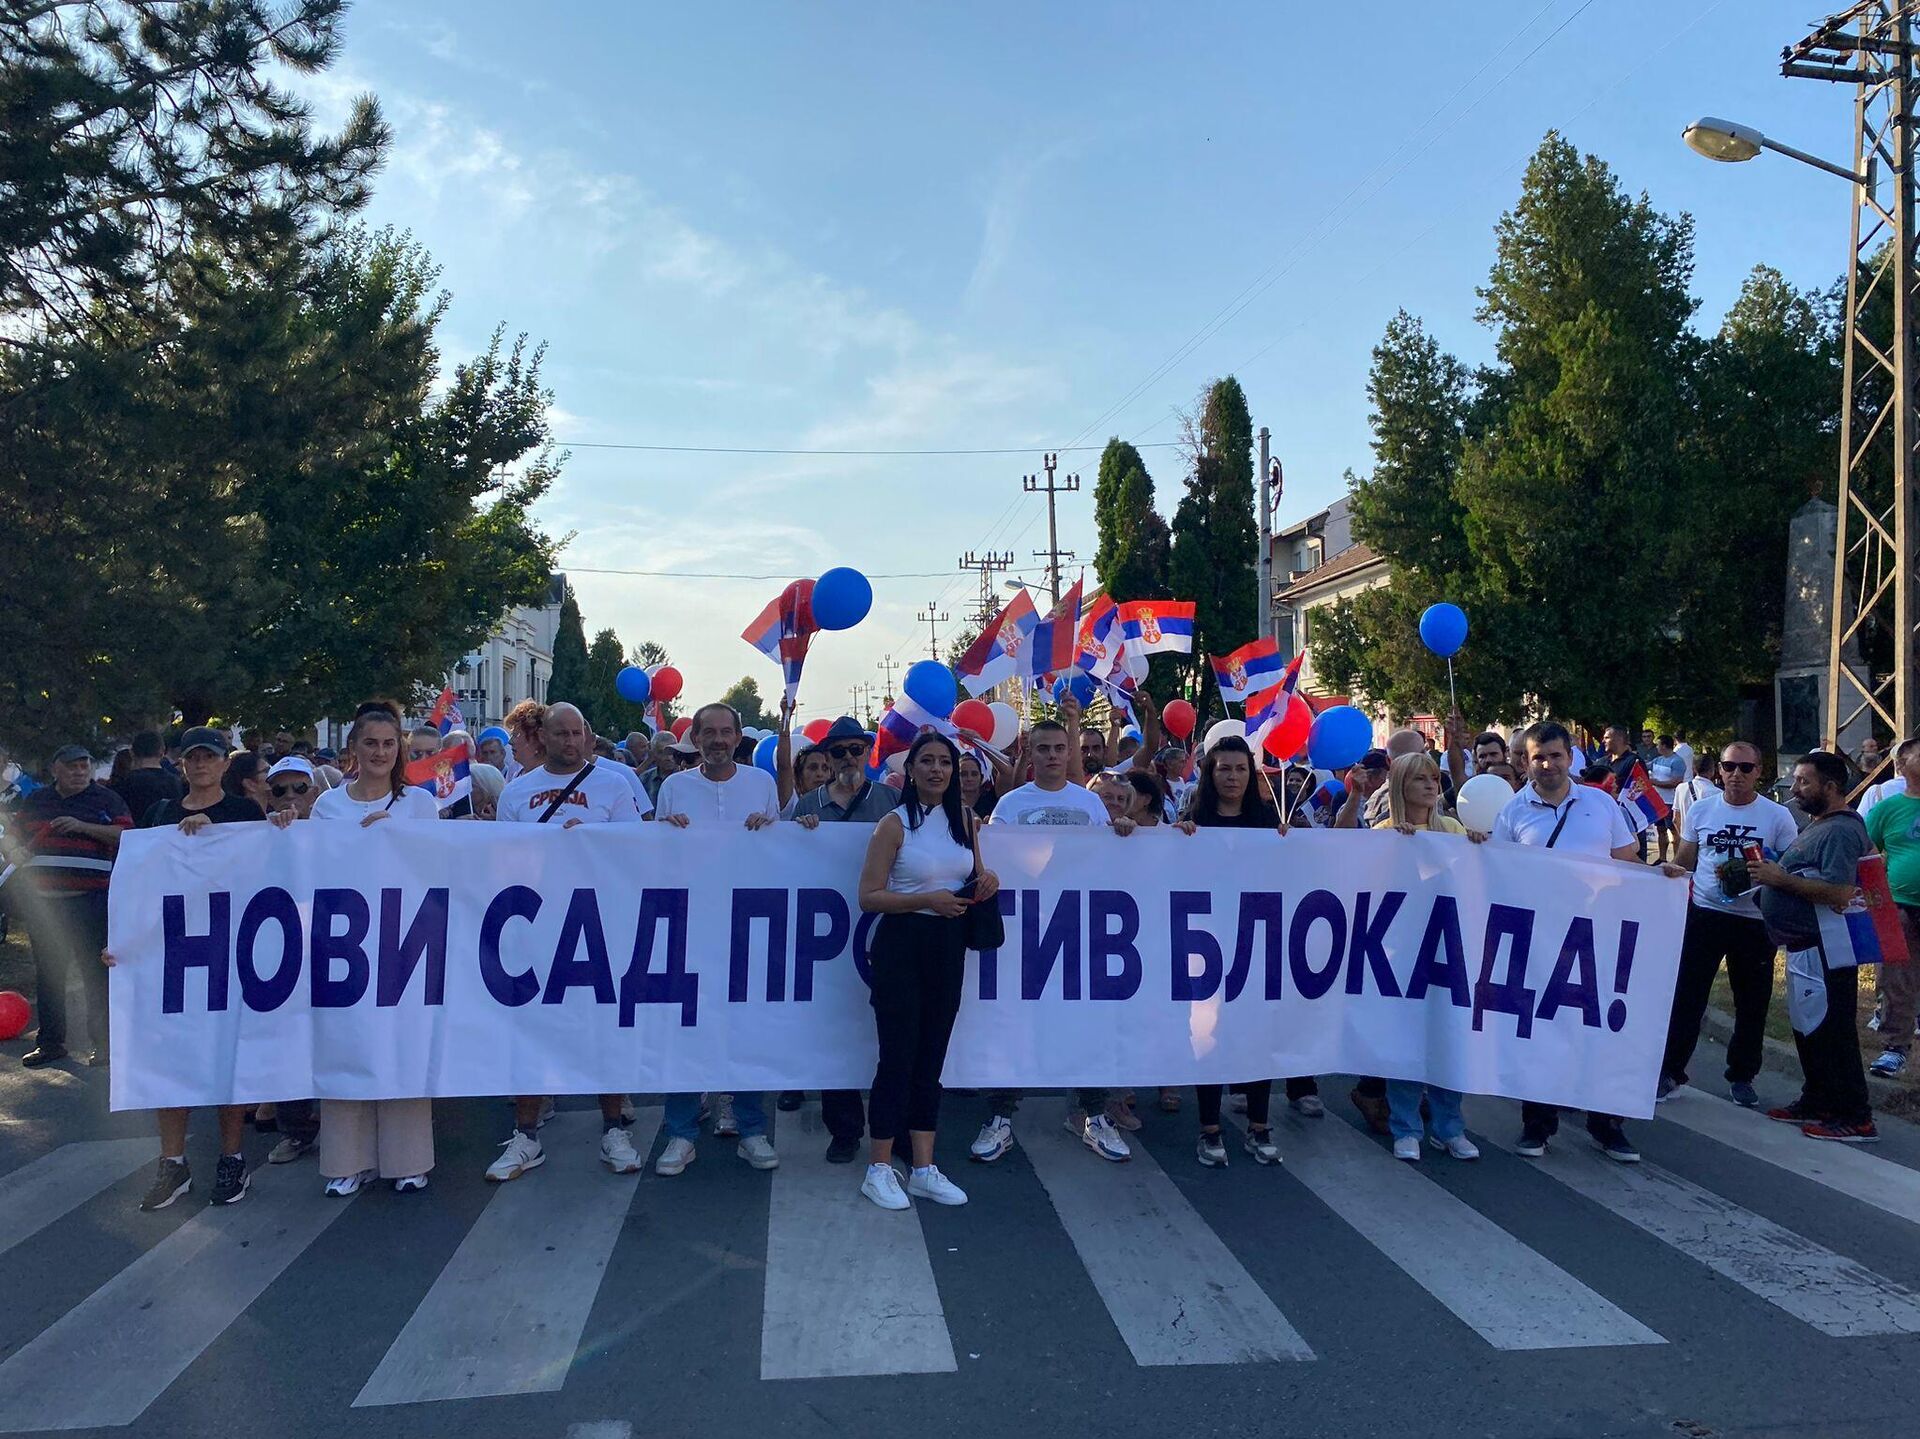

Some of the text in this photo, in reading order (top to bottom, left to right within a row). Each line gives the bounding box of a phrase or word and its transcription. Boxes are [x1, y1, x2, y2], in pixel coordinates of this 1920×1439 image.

[529, 789, 589, 809] СРБЈА
[162, 884, 1640, 1040] НОВИ САД ПРИВ БЛОКАДА!
